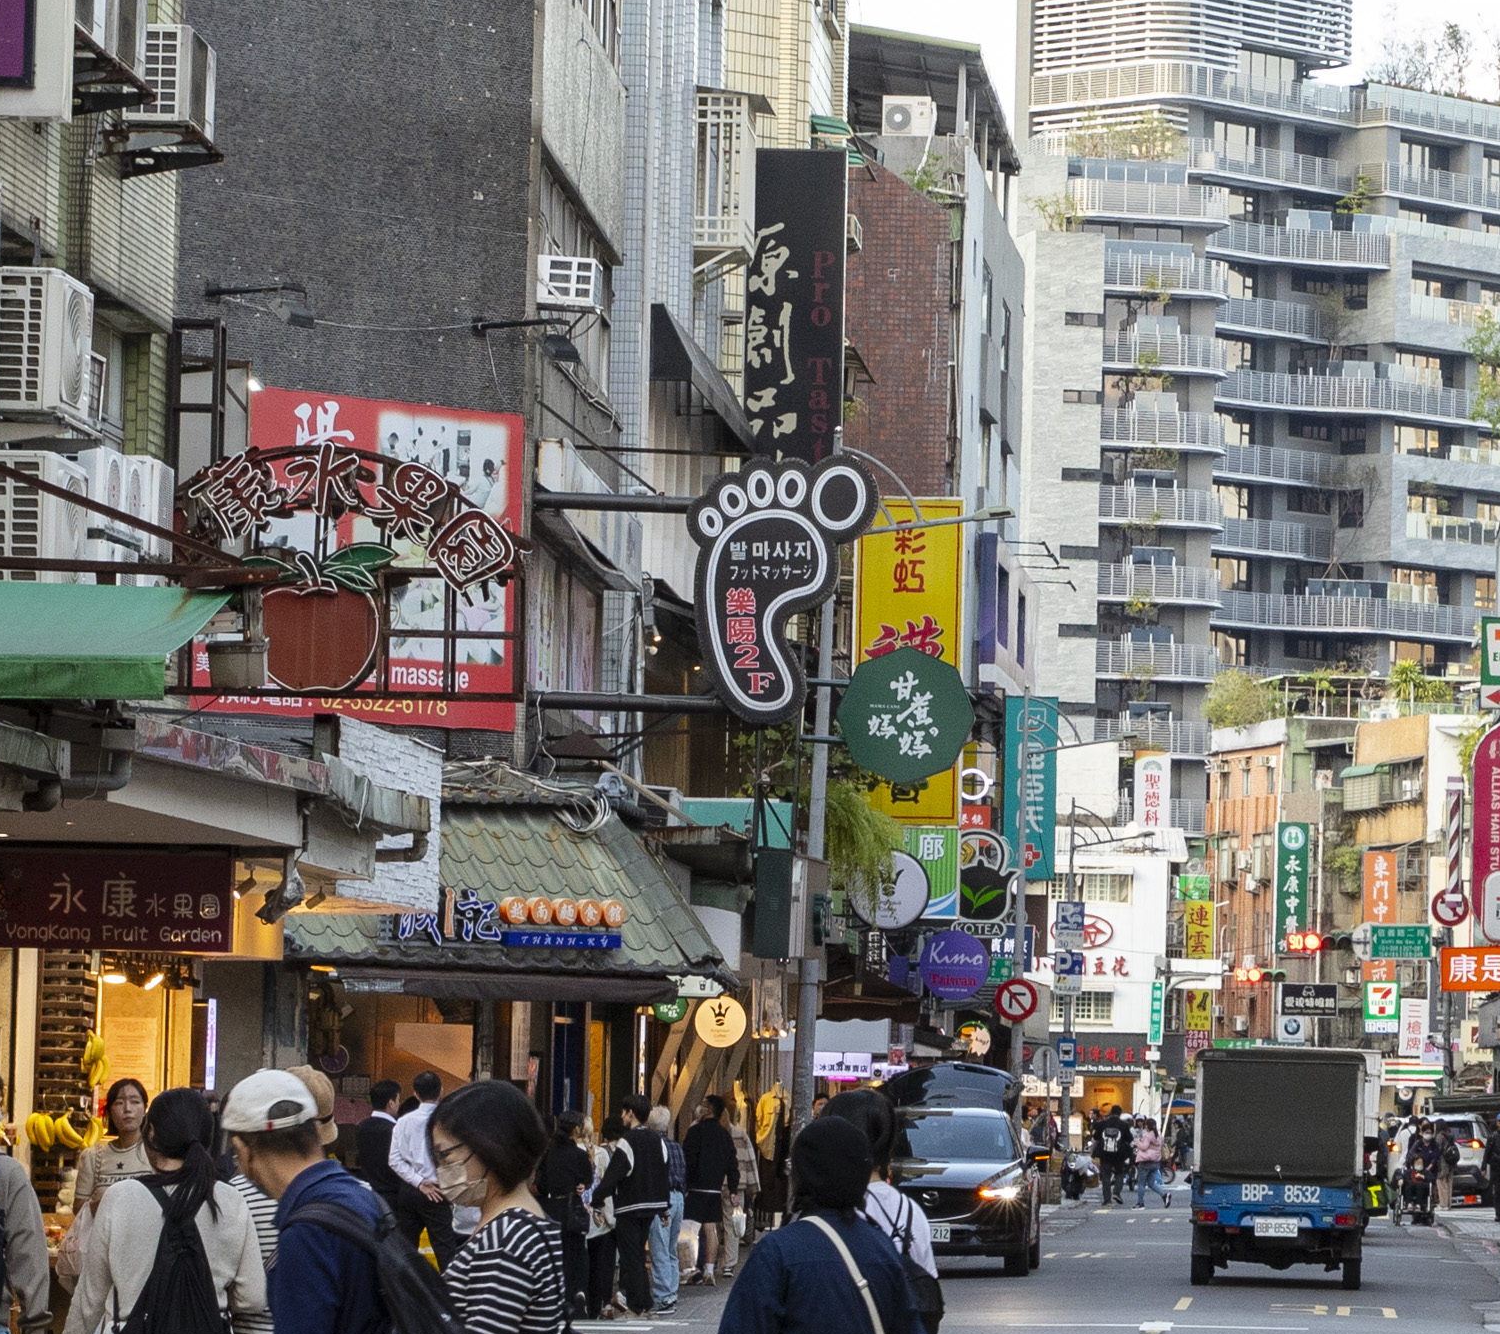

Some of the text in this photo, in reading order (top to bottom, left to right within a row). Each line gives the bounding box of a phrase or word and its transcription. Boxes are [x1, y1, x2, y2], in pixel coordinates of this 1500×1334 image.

[749, 222, 798, 457] 原創品
[808, 251, 835, 462] Pro Tast
[894, 520, 927, 594] 彩虹
[729, 564, 812, 581] フットマッサージ
[1144, 773, 1161, 827] 聖德科
[1491, 766, 1500, 810] ALLIAS
[1490, 812, 1500, 844] HAIR
[917, 833, 945, 861] 廊
[510, 900, 622, 924] 越南麵食館
[5, 922, 222, 944] YongKang Fruit Garden
[1188, 905, 1210, 954] 連雲
[1377, 928, 1425, 938] 信義路二段
[929, 940, 984, 965] Kimo
[1056, 953, 1072, 972] P
[929, 973, 978, 987] Taiwan
[1406, 1003, 1422, 1051] 三槍牌
[1284, 1185, 1320, 1204] 8532
[1255, 1221, 1298, 1234] BBP-8532
